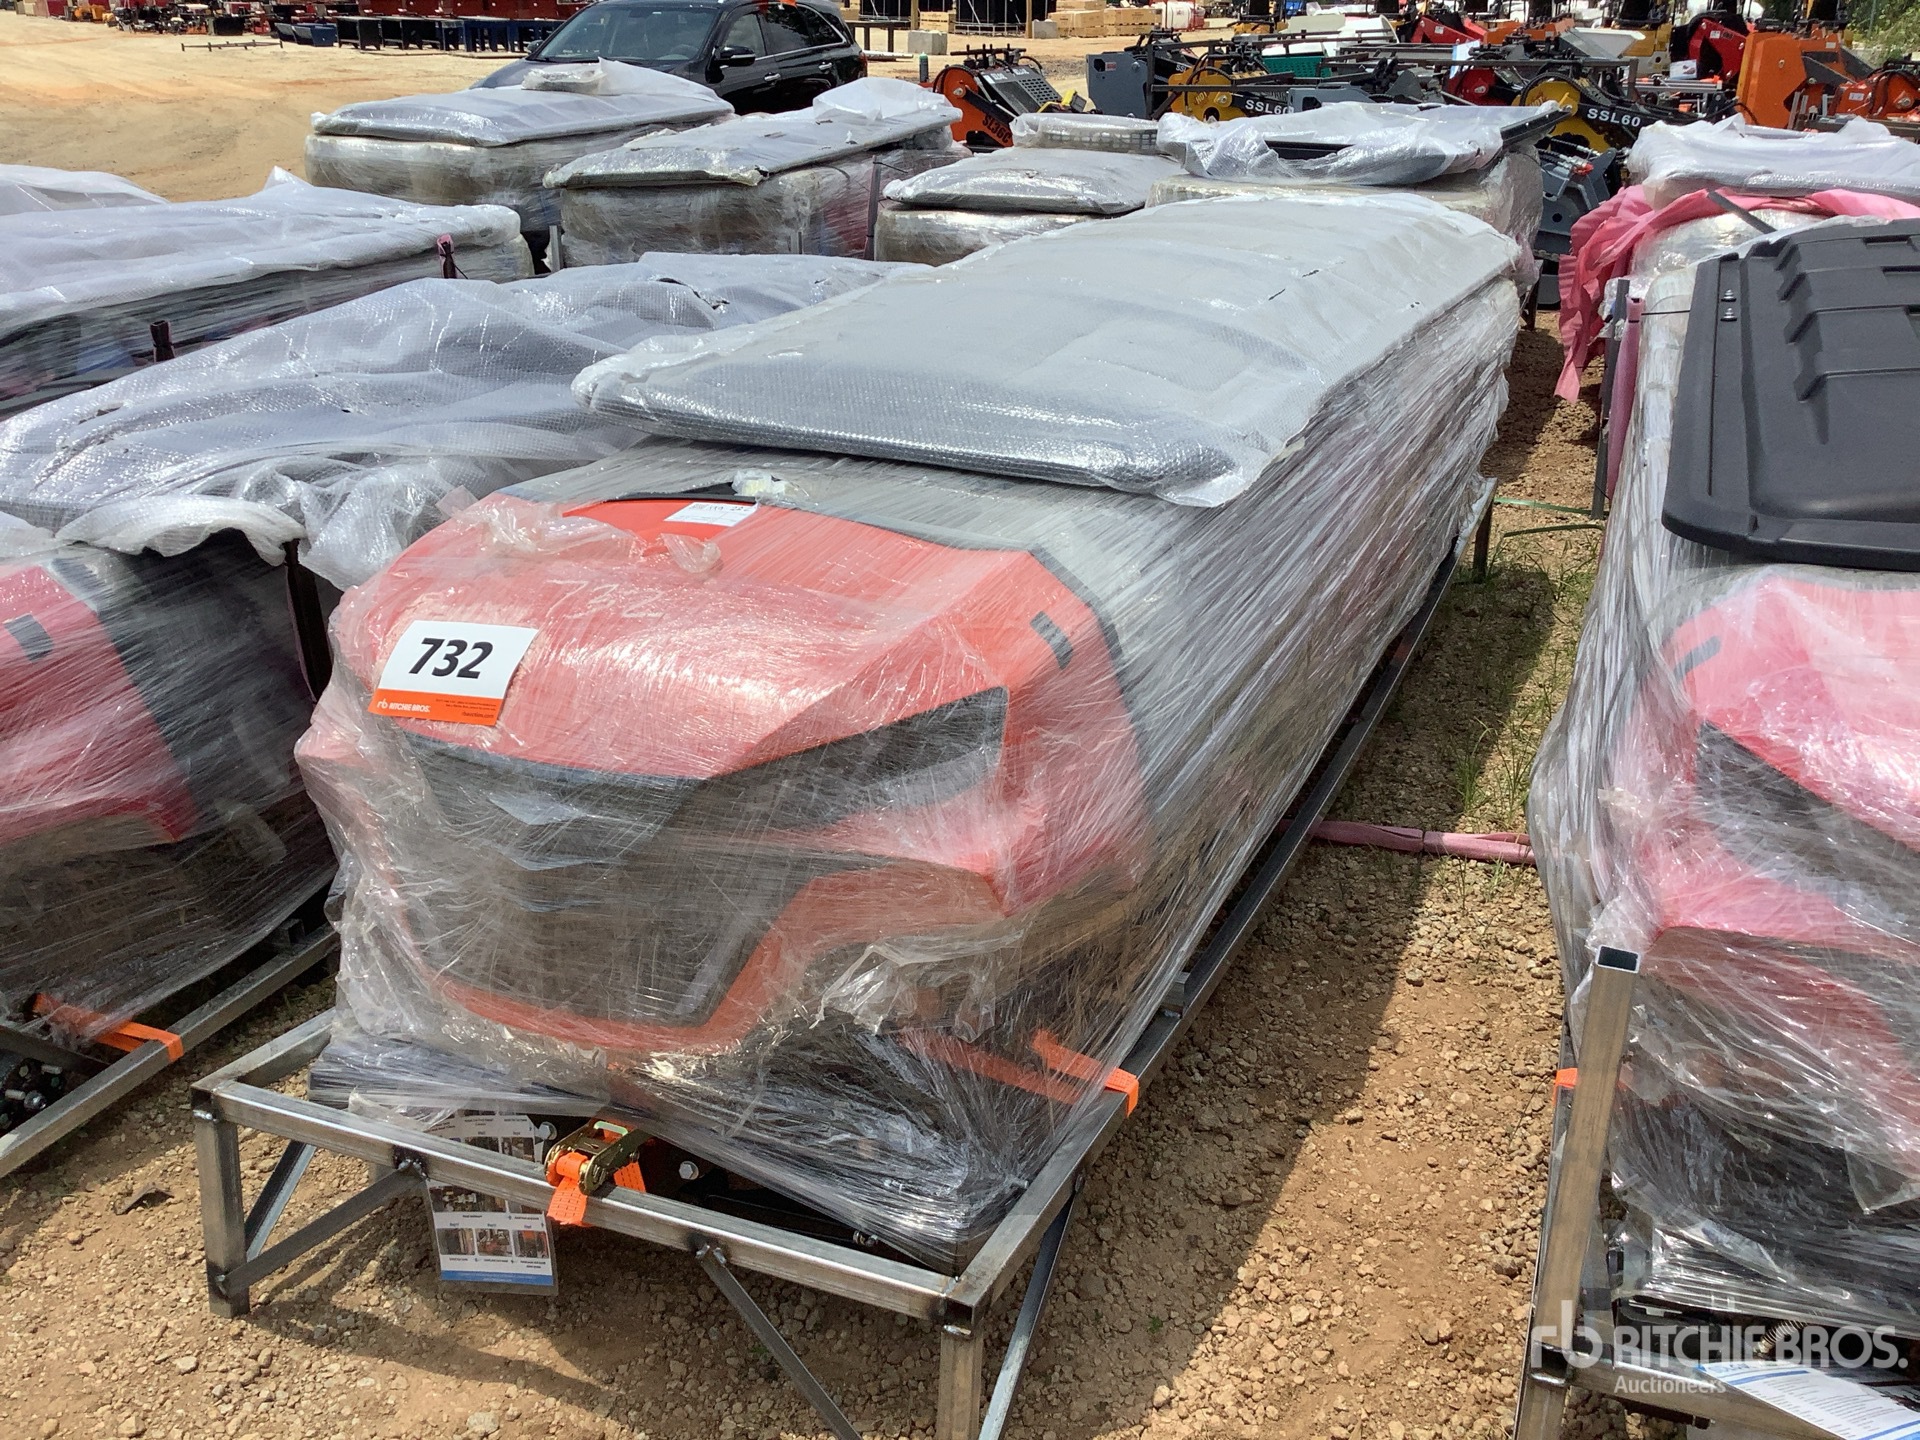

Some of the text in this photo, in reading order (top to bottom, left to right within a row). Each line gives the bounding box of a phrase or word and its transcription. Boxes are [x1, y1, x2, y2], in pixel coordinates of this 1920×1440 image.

[1587, 108, 1641, 127] SSL60
[546, 579, 665, 619] 732
[408, 637, 493, 680] 732
[389, 701, 412, 711] RITCHIE
